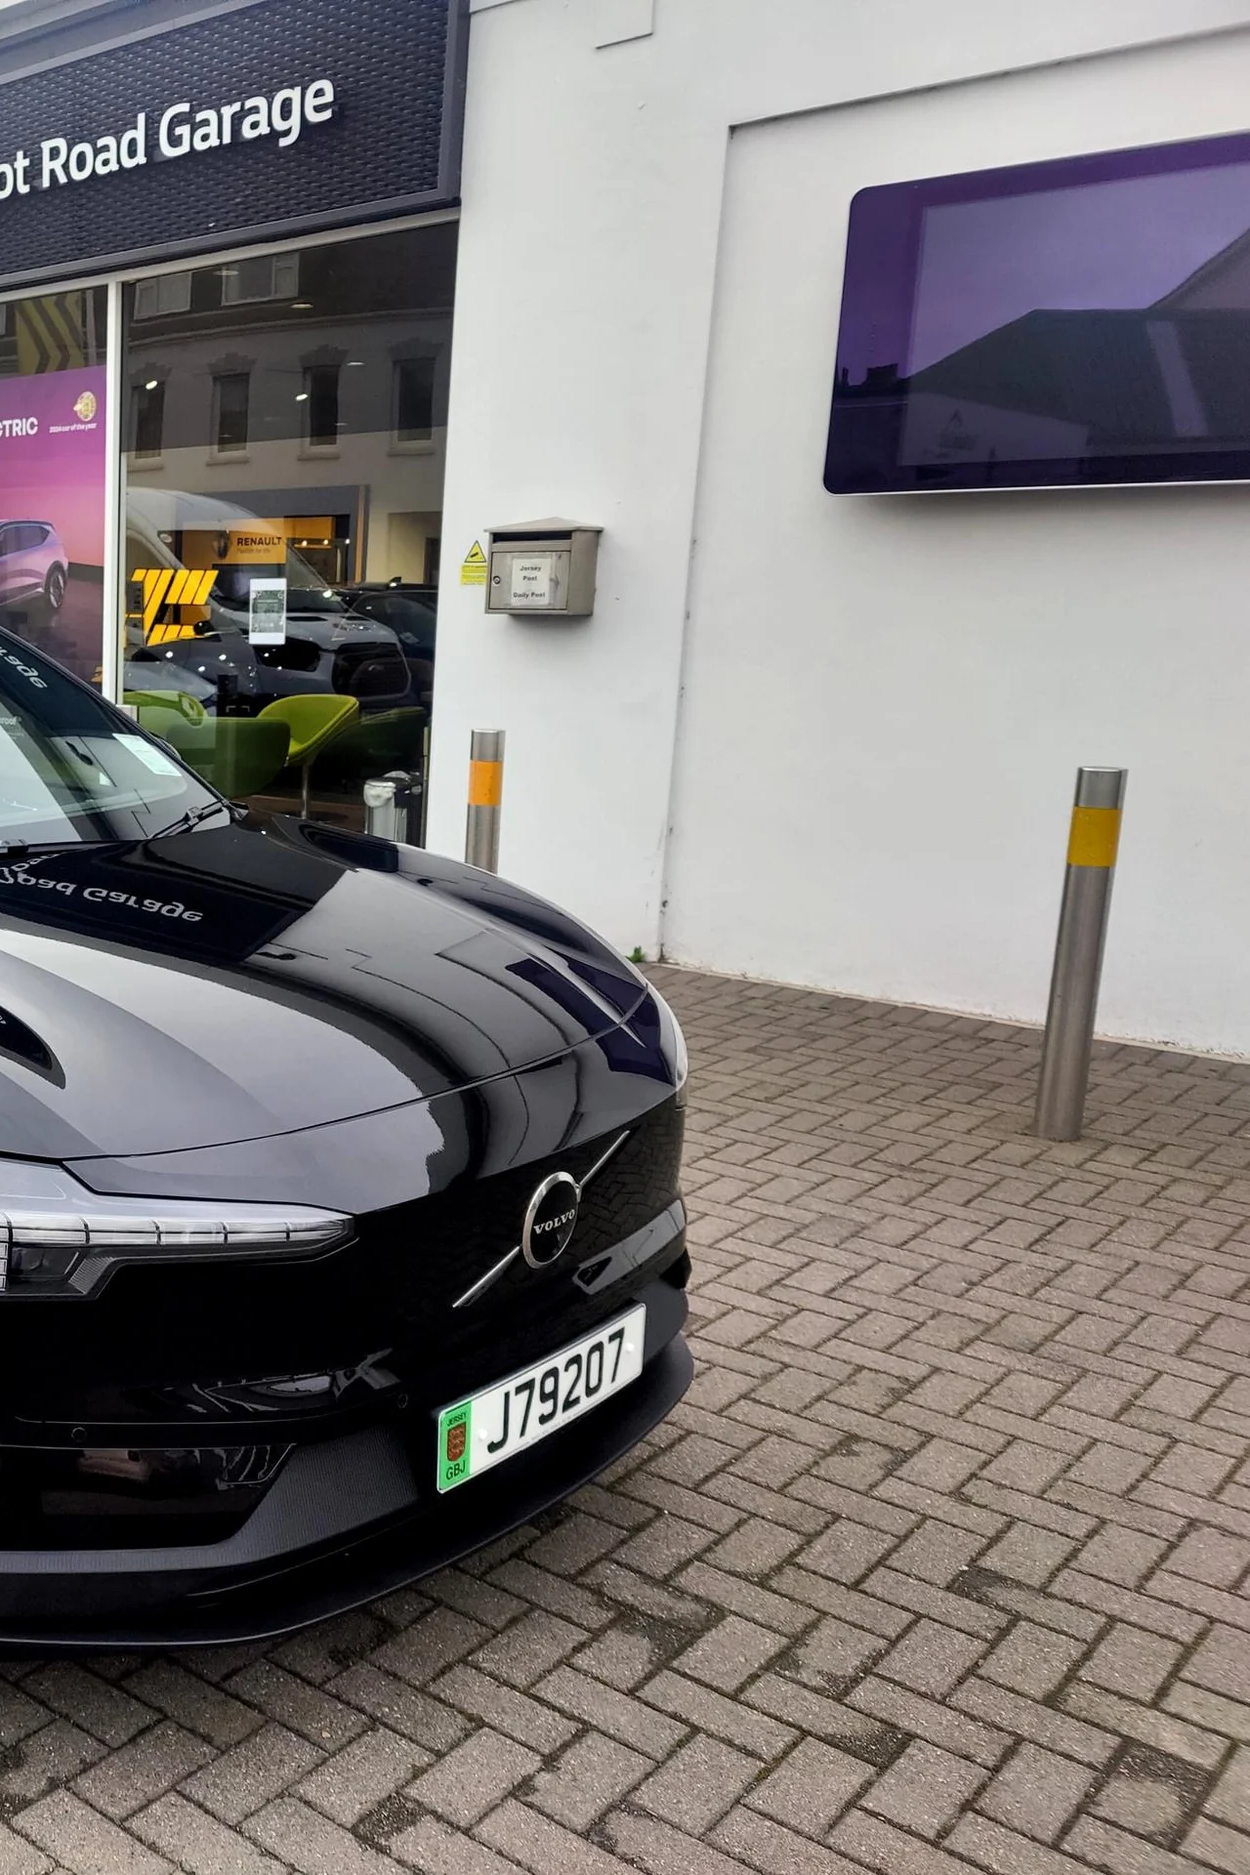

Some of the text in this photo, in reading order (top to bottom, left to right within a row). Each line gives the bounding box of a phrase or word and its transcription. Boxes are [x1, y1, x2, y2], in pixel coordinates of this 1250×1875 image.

[40, 112, 147, 188] Road
[159, 78, 335, 147] Garage
[237, 537, 281, 546] RENAULT
[533, 1209, 575, 1235] VOLVO
[487, 1327, 625, 1454] J79207
[447, 1412, 467, 1427] JERSEY
[446, 1461, 466, 1480] GBJ
